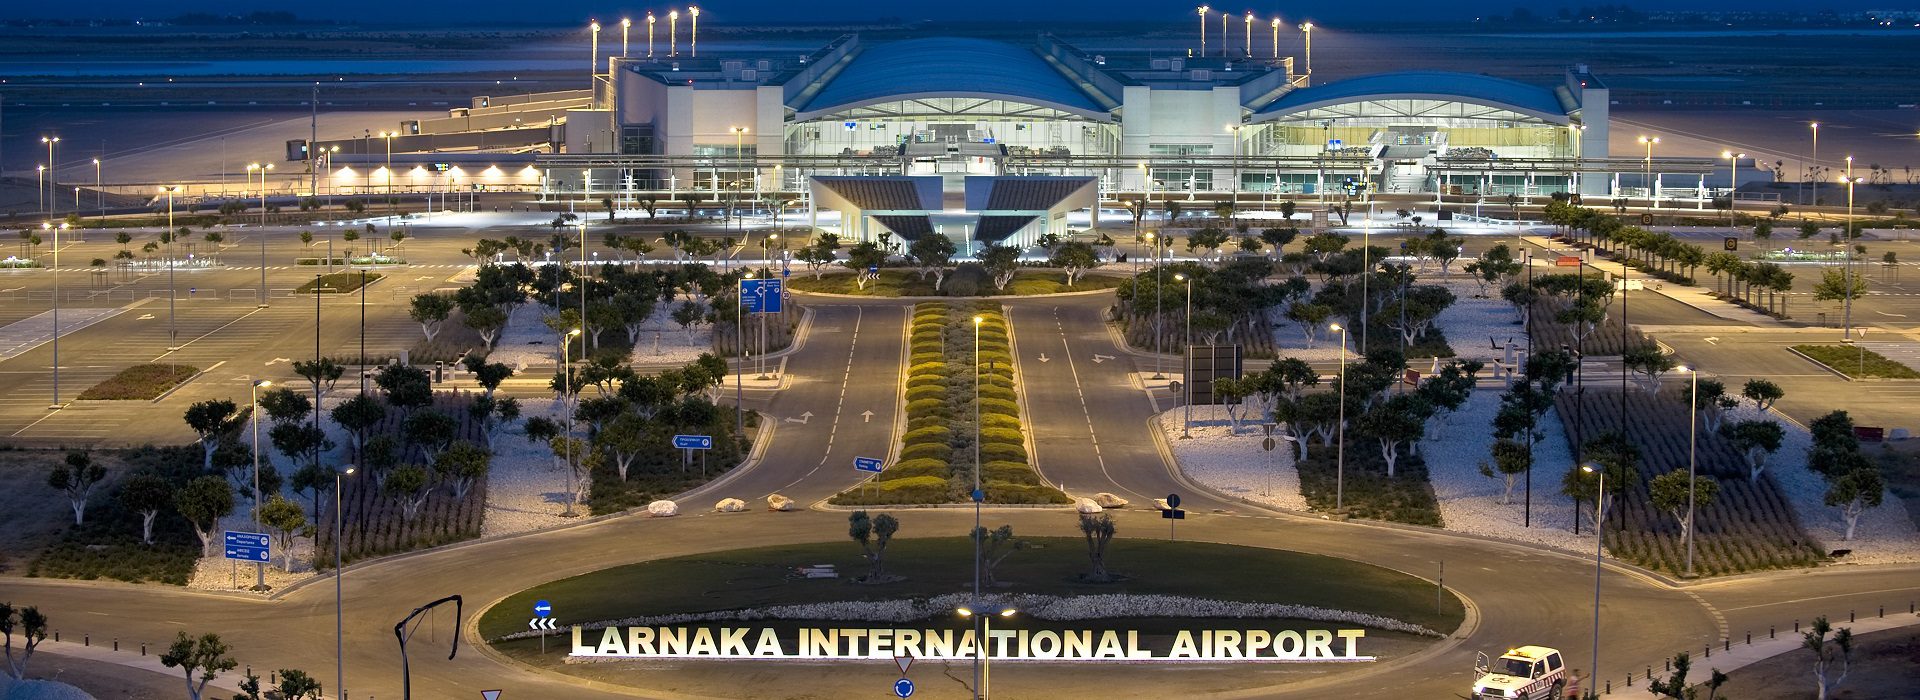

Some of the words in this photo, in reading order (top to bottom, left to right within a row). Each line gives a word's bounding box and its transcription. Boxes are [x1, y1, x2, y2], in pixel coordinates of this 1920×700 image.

[572, 626, 784, 657] LARNAKA
[799, 627, 1152, 658] INTERNATIONAL
[1169, 629, 1366, 658] AIRPORT
